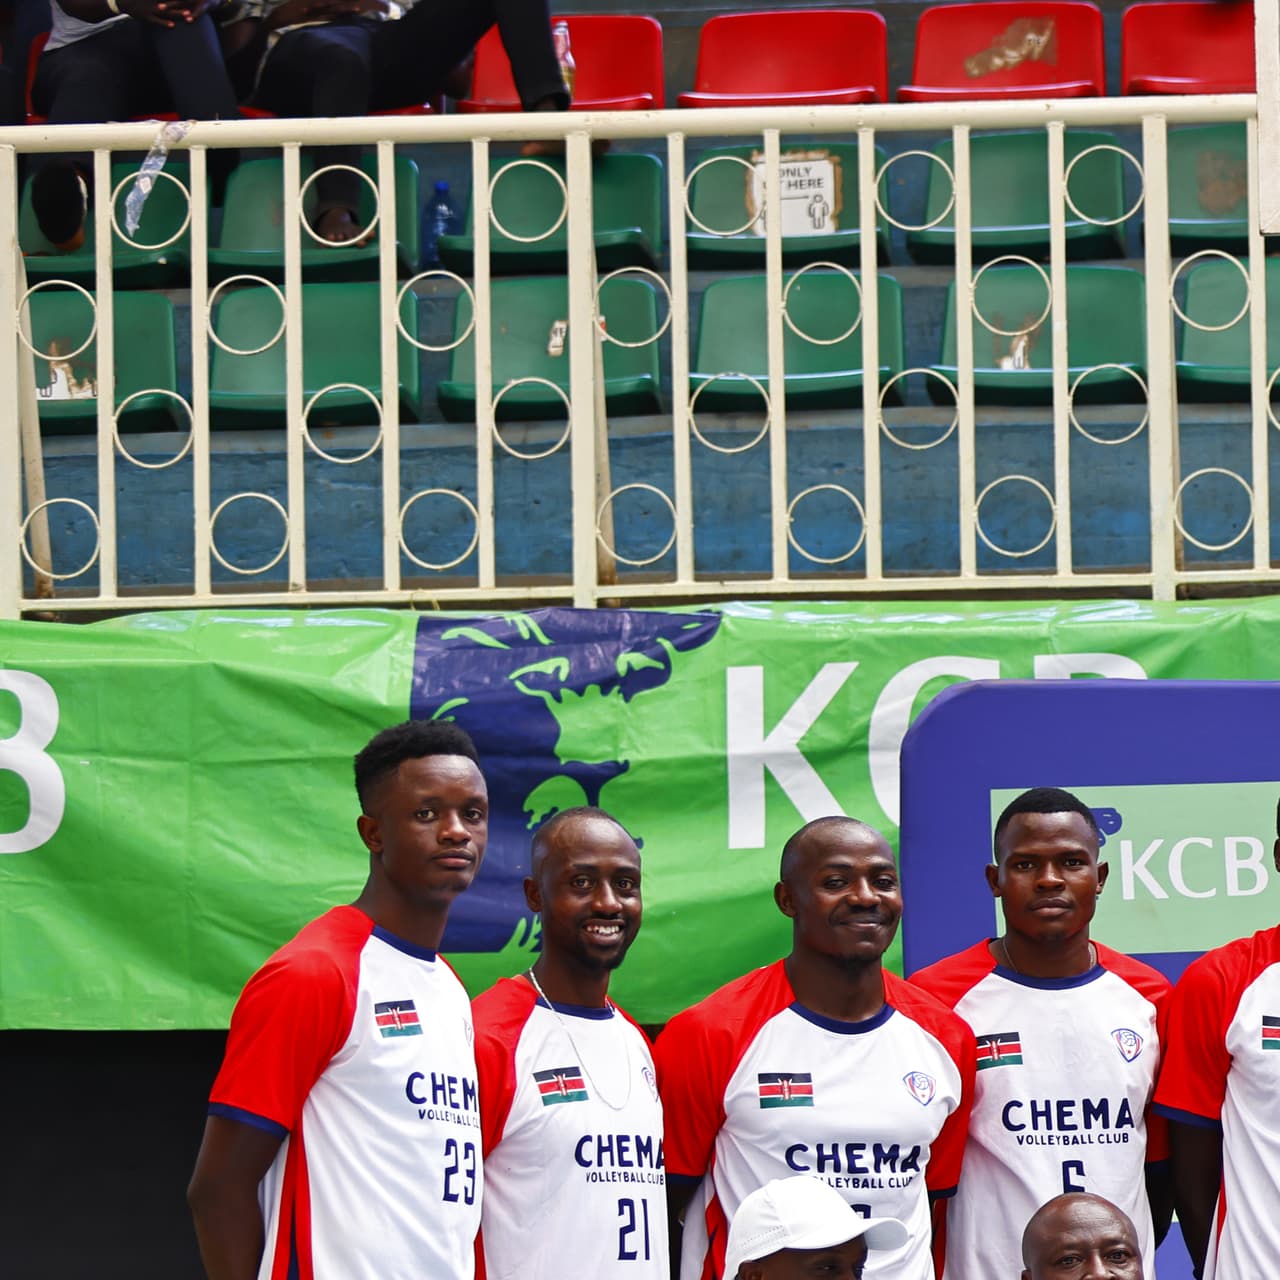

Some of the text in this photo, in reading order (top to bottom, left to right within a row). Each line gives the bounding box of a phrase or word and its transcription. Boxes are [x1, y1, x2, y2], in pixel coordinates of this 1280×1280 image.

[1121, 836, 1269, 901] KCB
[405, 1071, 478, 1113] CHEM
[1002, 1098, 1135, 1132] CHEMA
[1016, 1132, 1129, 1147] VOLLEYBALL CLUB
[443, 1138, 477, 1206] 23
[785, 1142, 922, 1175] CHEMA
[586, 1171, 645, 1184] VOLLEYBALL
[813, 1176, 885, 1189] LEYBALL
[617, 1198, 650, 1261] 21
